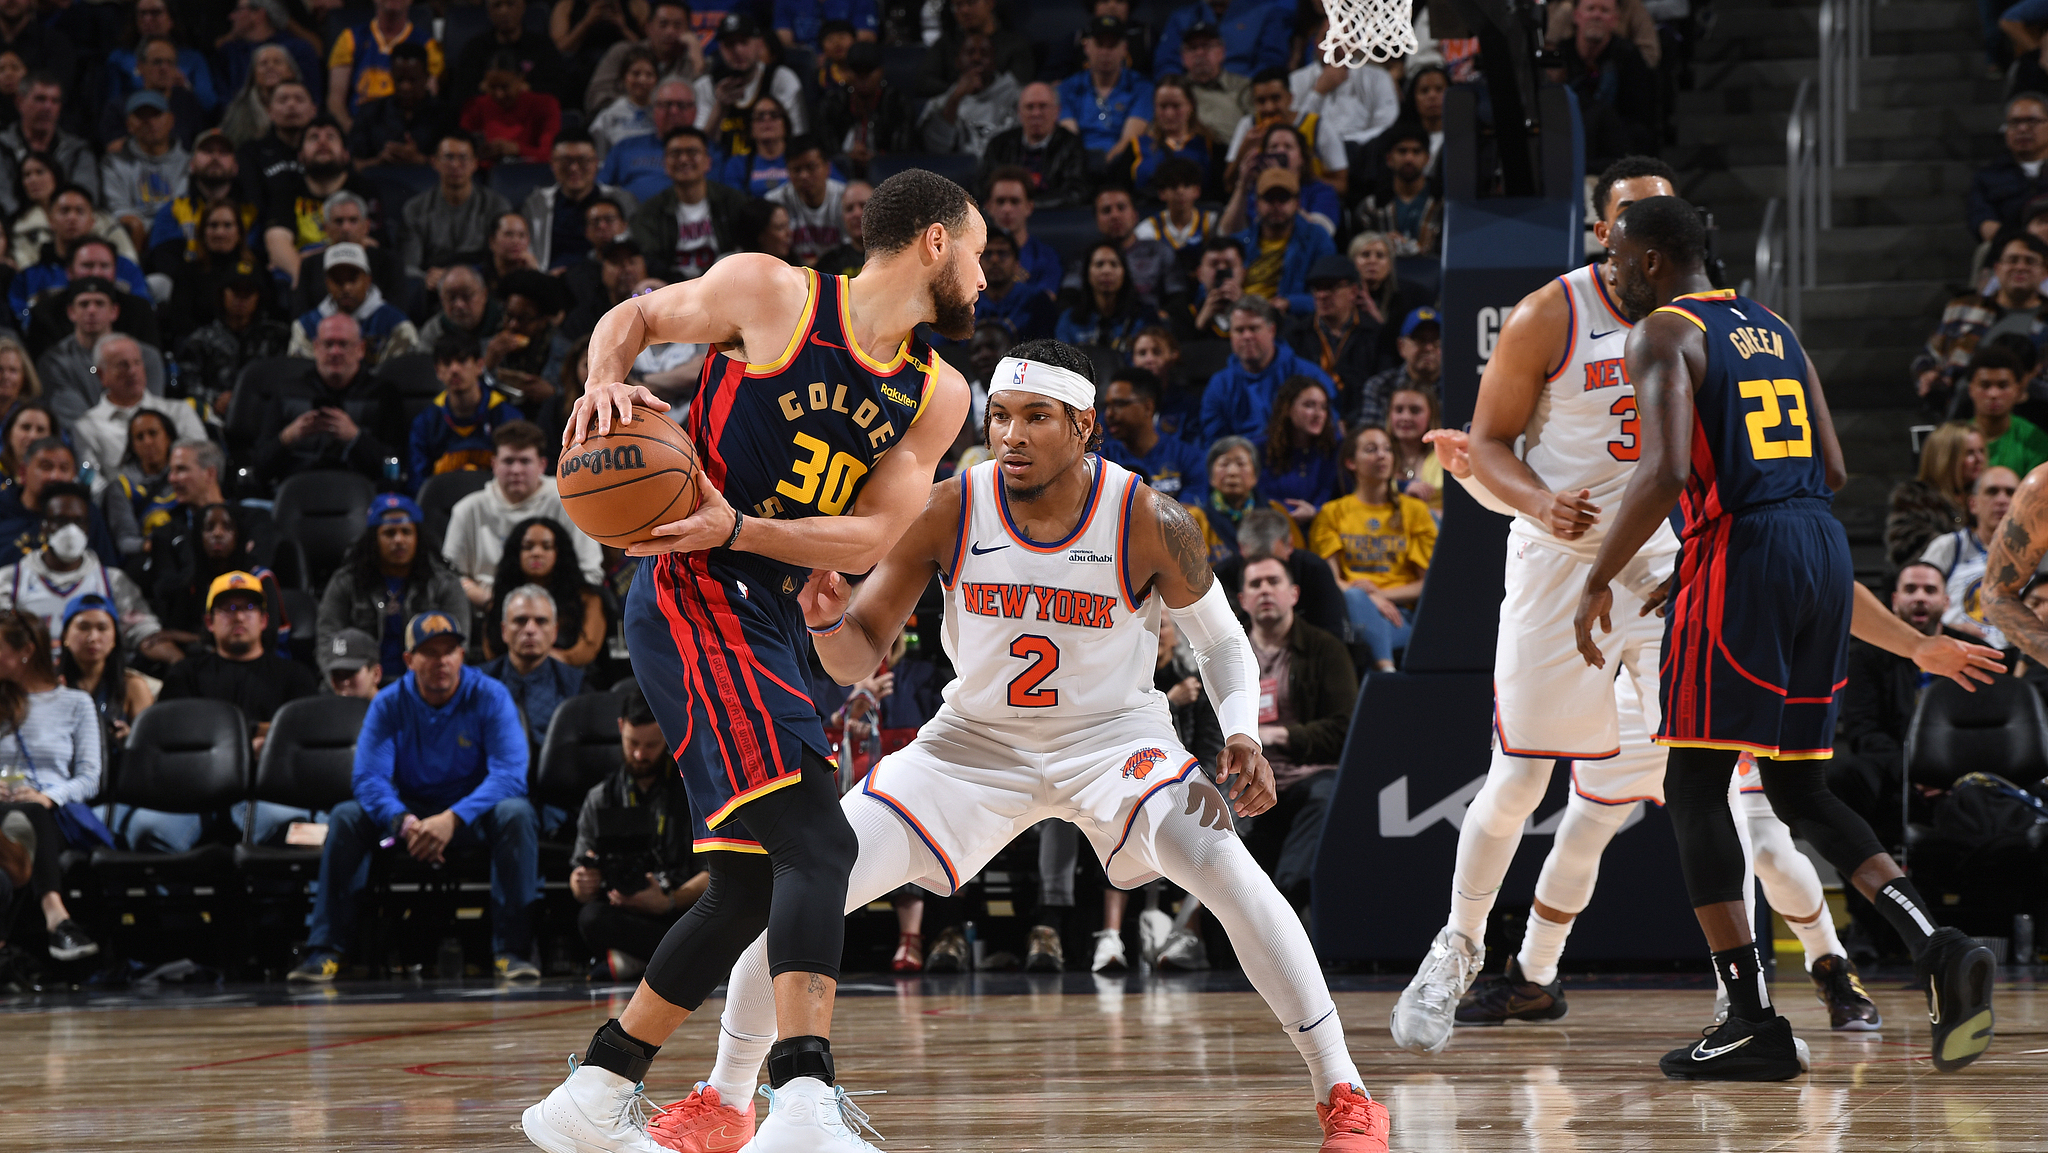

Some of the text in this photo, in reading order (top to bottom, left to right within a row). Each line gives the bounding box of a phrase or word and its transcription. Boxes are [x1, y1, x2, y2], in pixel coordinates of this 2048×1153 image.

[1729, 327, 1784, 360] GREEN
[881, 383, 917, 409] Rakuten
[1738, 378, 1812, 460] 23
[561, 444, 646, 478] Wilson
[775, 431, 868, 517] 30
[1069, 554, 1112, 562] abu dhabi
[962, 582, 1118, 629] NEW YORK
[1007, 634, 1060, 708] 2
[712, 657, 760, 779] GOLDEN STATE WARRIORS
[1122, 747, 1167, 779] KNICKS
